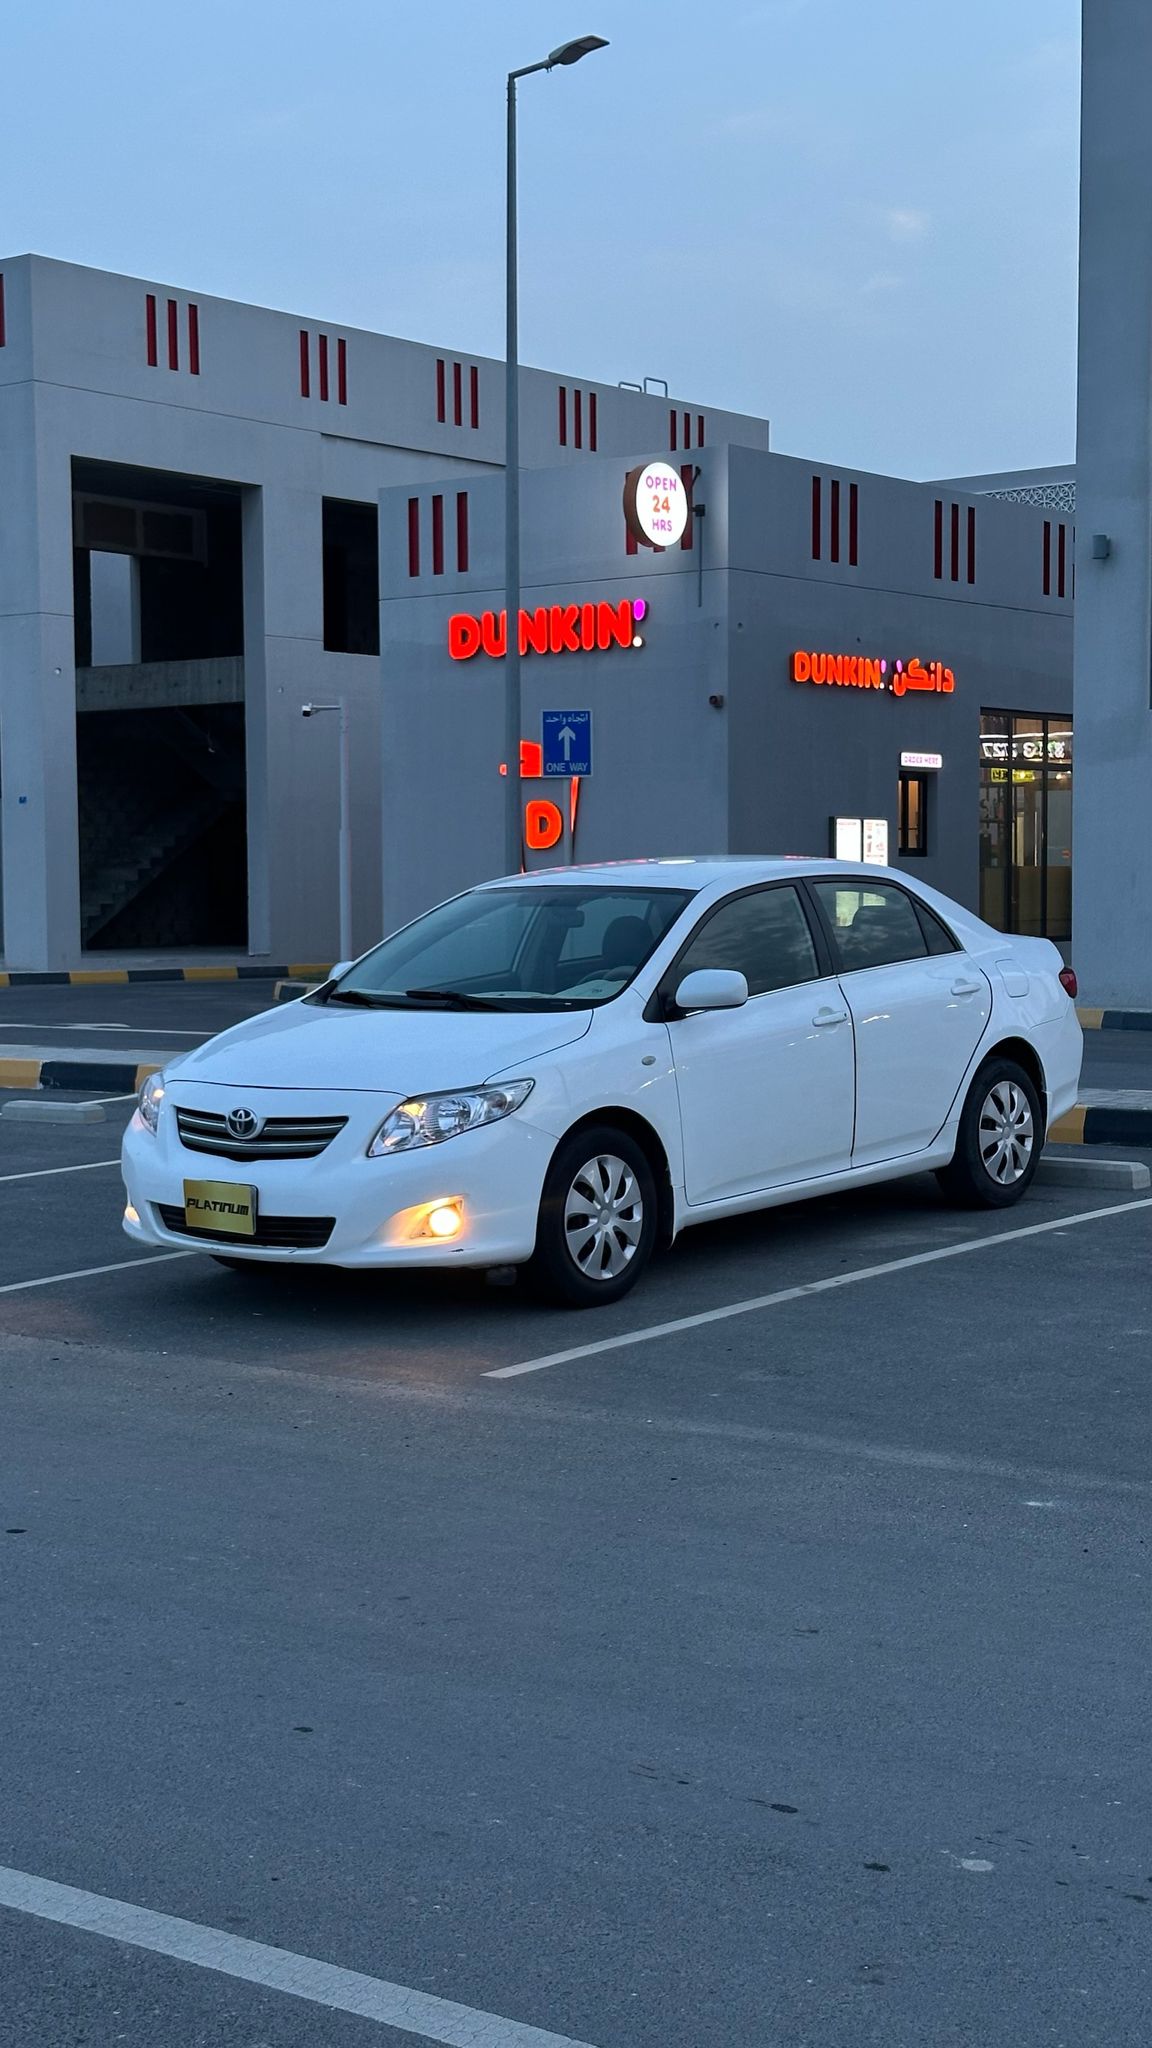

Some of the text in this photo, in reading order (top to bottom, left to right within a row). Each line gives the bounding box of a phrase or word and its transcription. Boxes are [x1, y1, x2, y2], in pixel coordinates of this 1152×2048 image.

[645, 475, 677, 491] OPEN
[652, 494, 670, 514] 24
[652, 518, 673, 532] HRS
[545, 714, 567, 725] واحد
[546, 762, 588, 773] ONE WAY
[186, 1197, 249, 1216] PLATINUM
